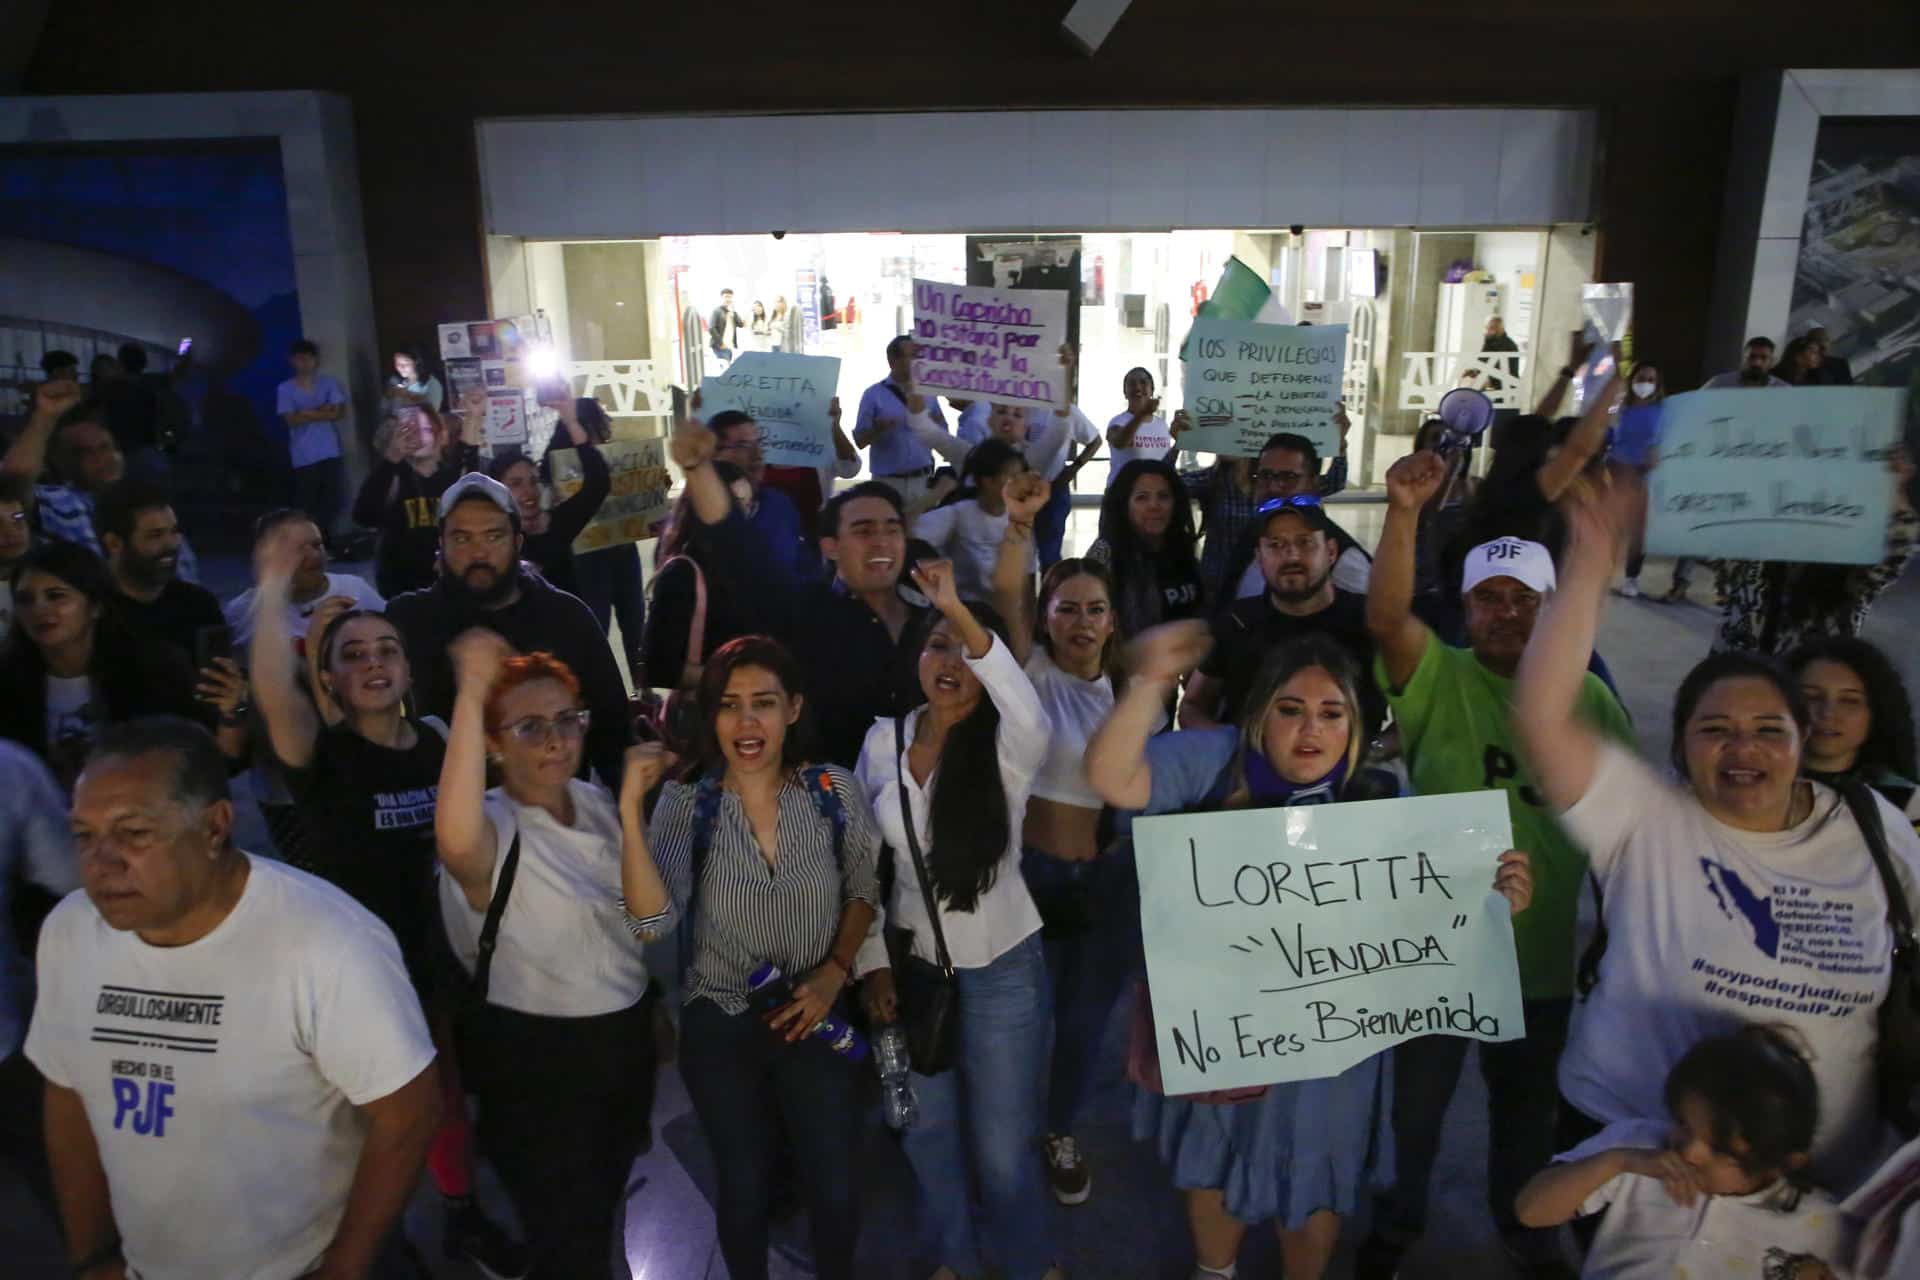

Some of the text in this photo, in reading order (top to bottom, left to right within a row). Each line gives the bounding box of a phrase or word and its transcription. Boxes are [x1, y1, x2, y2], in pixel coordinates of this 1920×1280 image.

[917, 285, 1032, 325] Un Capricho
[914, 318, 1041, 360] no estará por
[1198, 337, 1227, 360] LOS
[912, 361, 1052, 400] Constitución
[981, 349, 999, 368] de
[1010, 353, 1028, 374] la
[1203, 368, 1238, 384] QUE
[1195, 397, 1234, 417] SON
[1485, 543, 1521, 562] PJF
[1189, 837, 1454, 908] LORETTA
[1691, 957, 1875, 1005] #soypoderjudicial
[1704, 980, 1857, 1018] #respetoalPJF
[97, 992, 223, 1026] ORGULLOSAMENTE
[1172, 991, 1500, 1074] No Eres Bienvenida
[111, 1059, 175, 1081] HECHO EN EL
[111, 1077, 176, 1138] PJF
